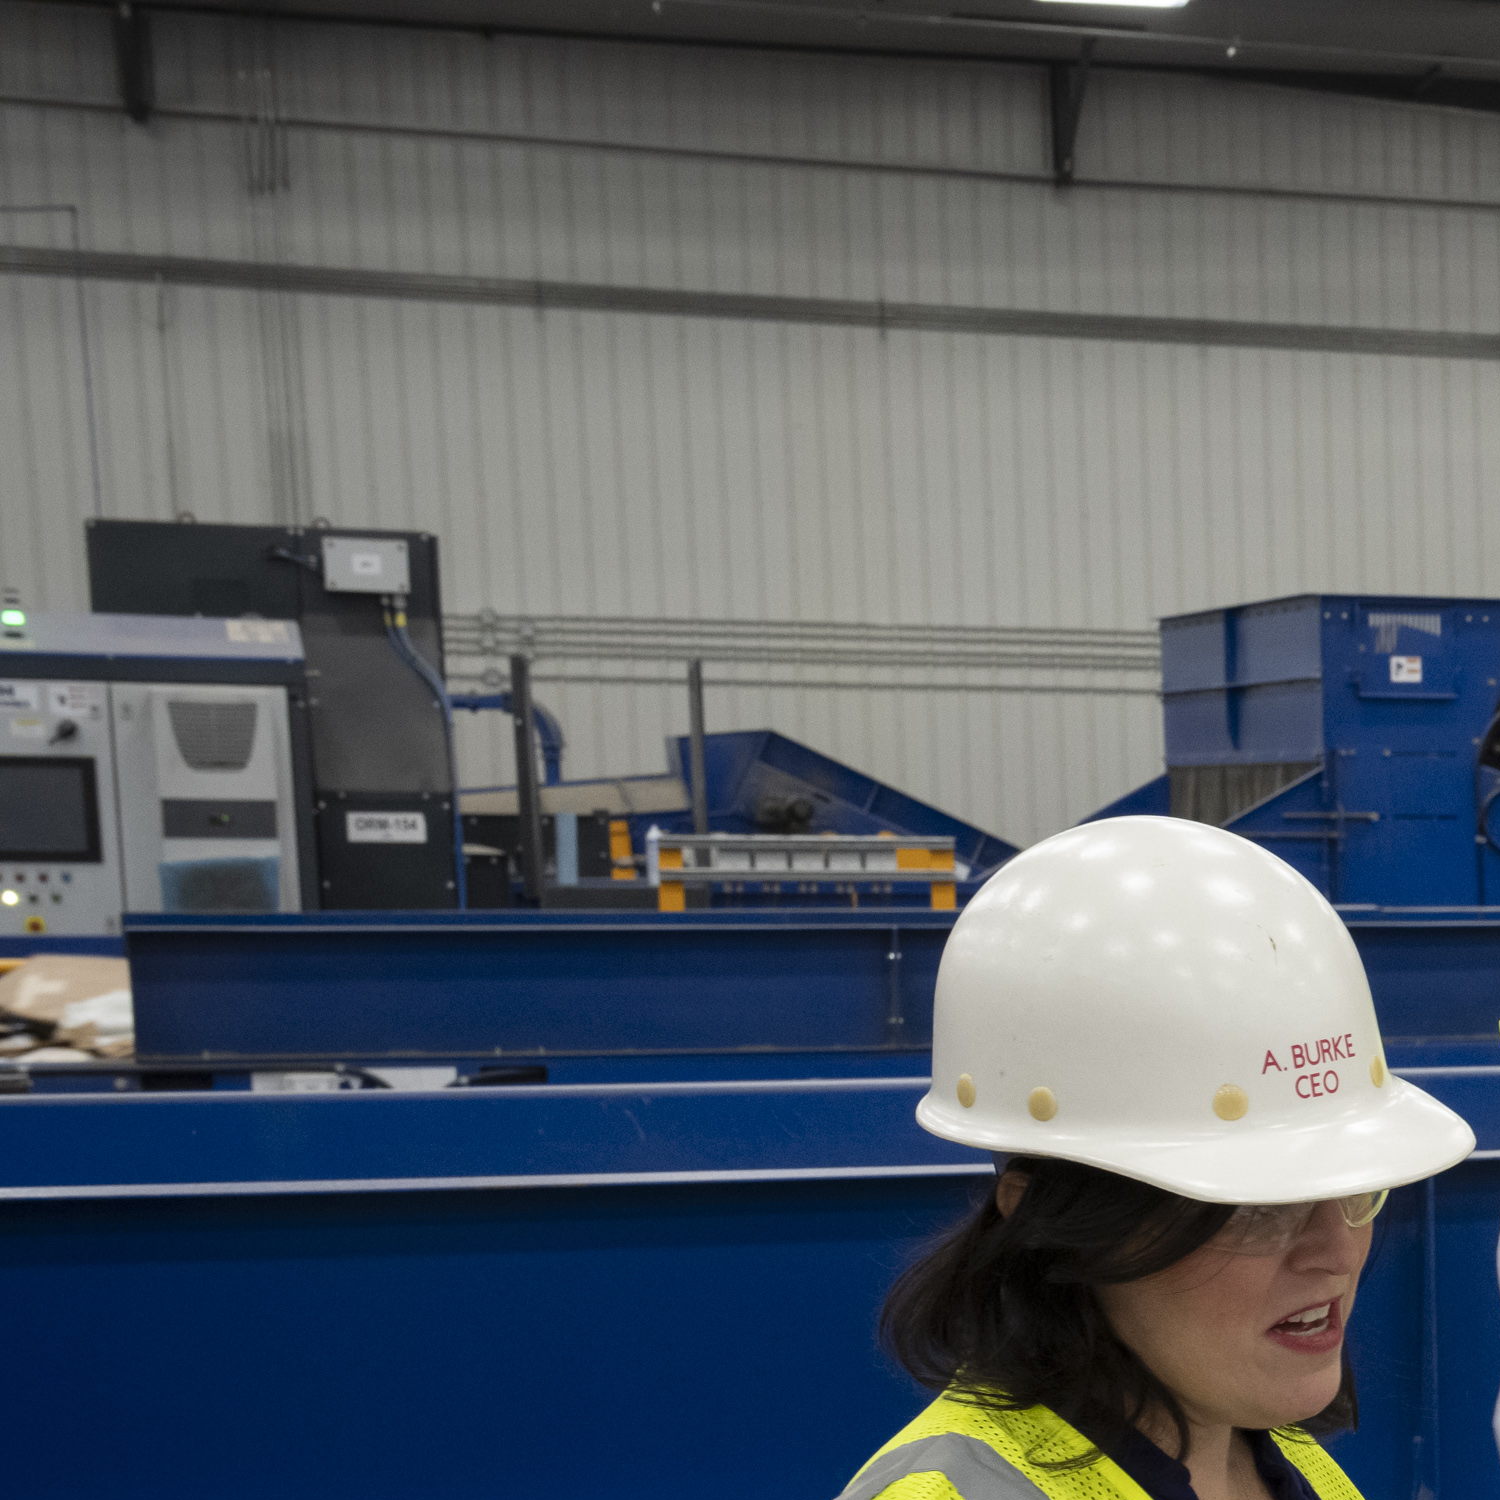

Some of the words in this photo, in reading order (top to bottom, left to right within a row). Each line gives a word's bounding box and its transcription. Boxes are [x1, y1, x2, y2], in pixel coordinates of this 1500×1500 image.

[1262, 1050, 1288, 1075] A.
[1291, 1033, 1356, 1069] BURKE
[1295, 1070, 1339, 1099] CEO
